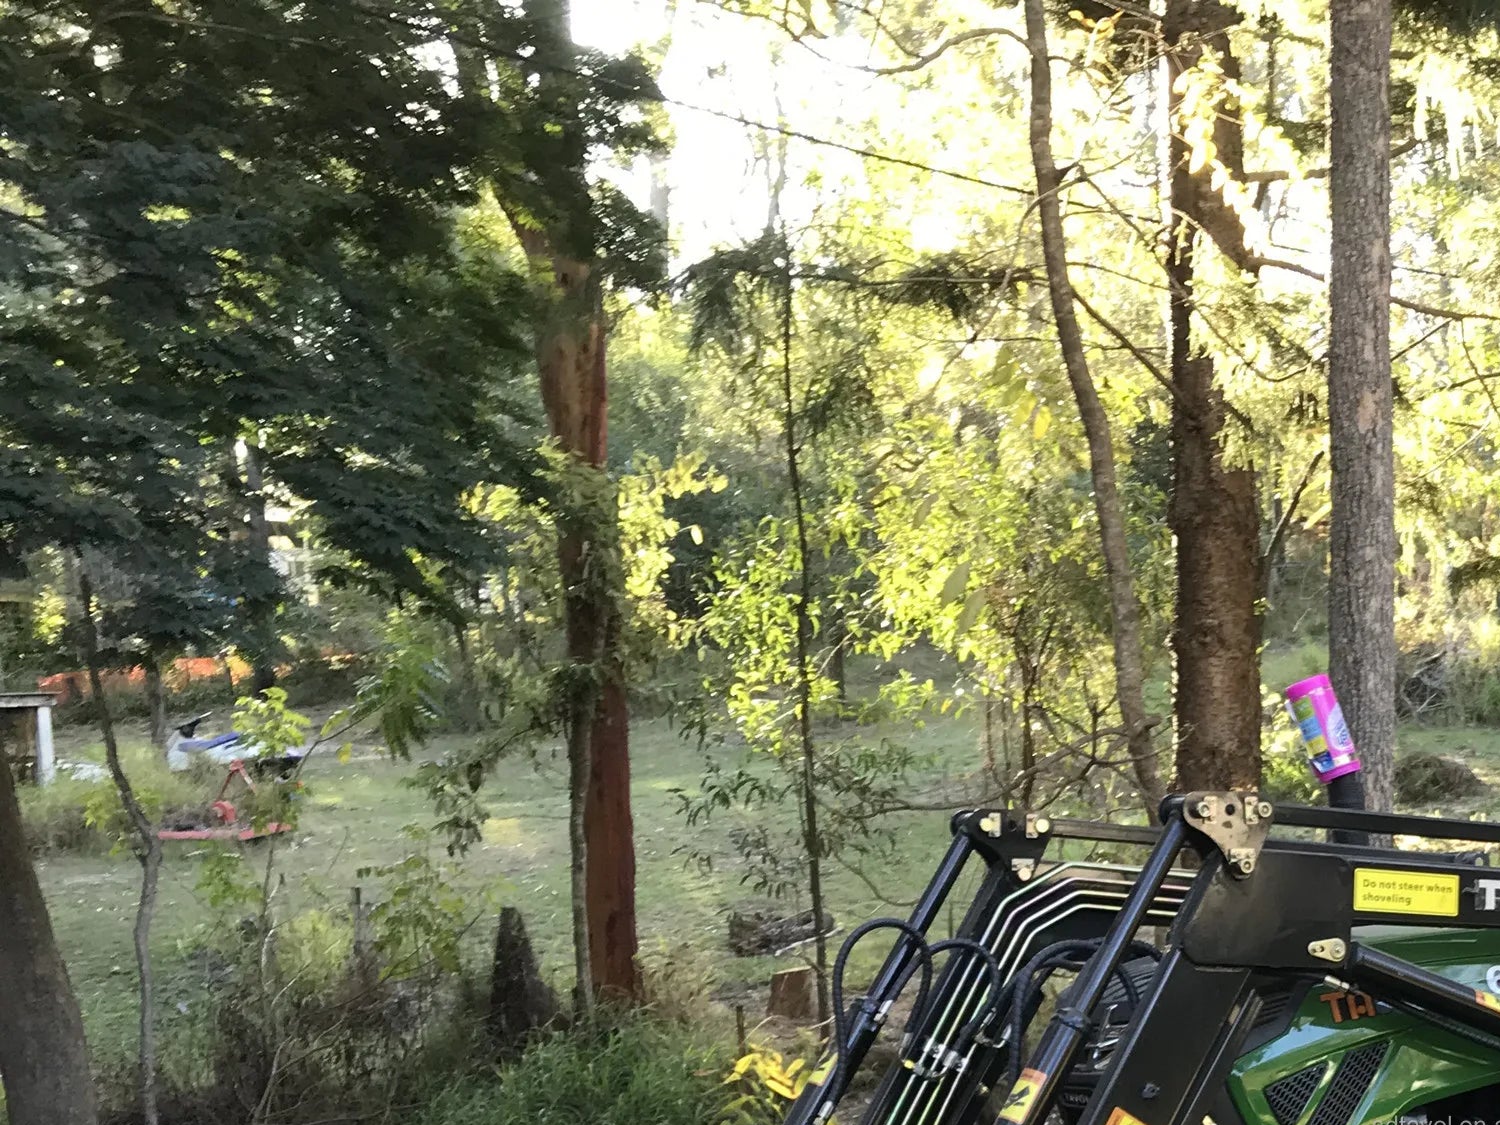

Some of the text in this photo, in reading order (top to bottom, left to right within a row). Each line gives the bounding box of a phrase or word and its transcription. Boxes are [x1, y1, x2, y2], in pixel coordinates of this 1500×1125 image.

[1362, 879, 1453, 894] Do not steer when
[1362, 892, 1412, 906] shoveling
